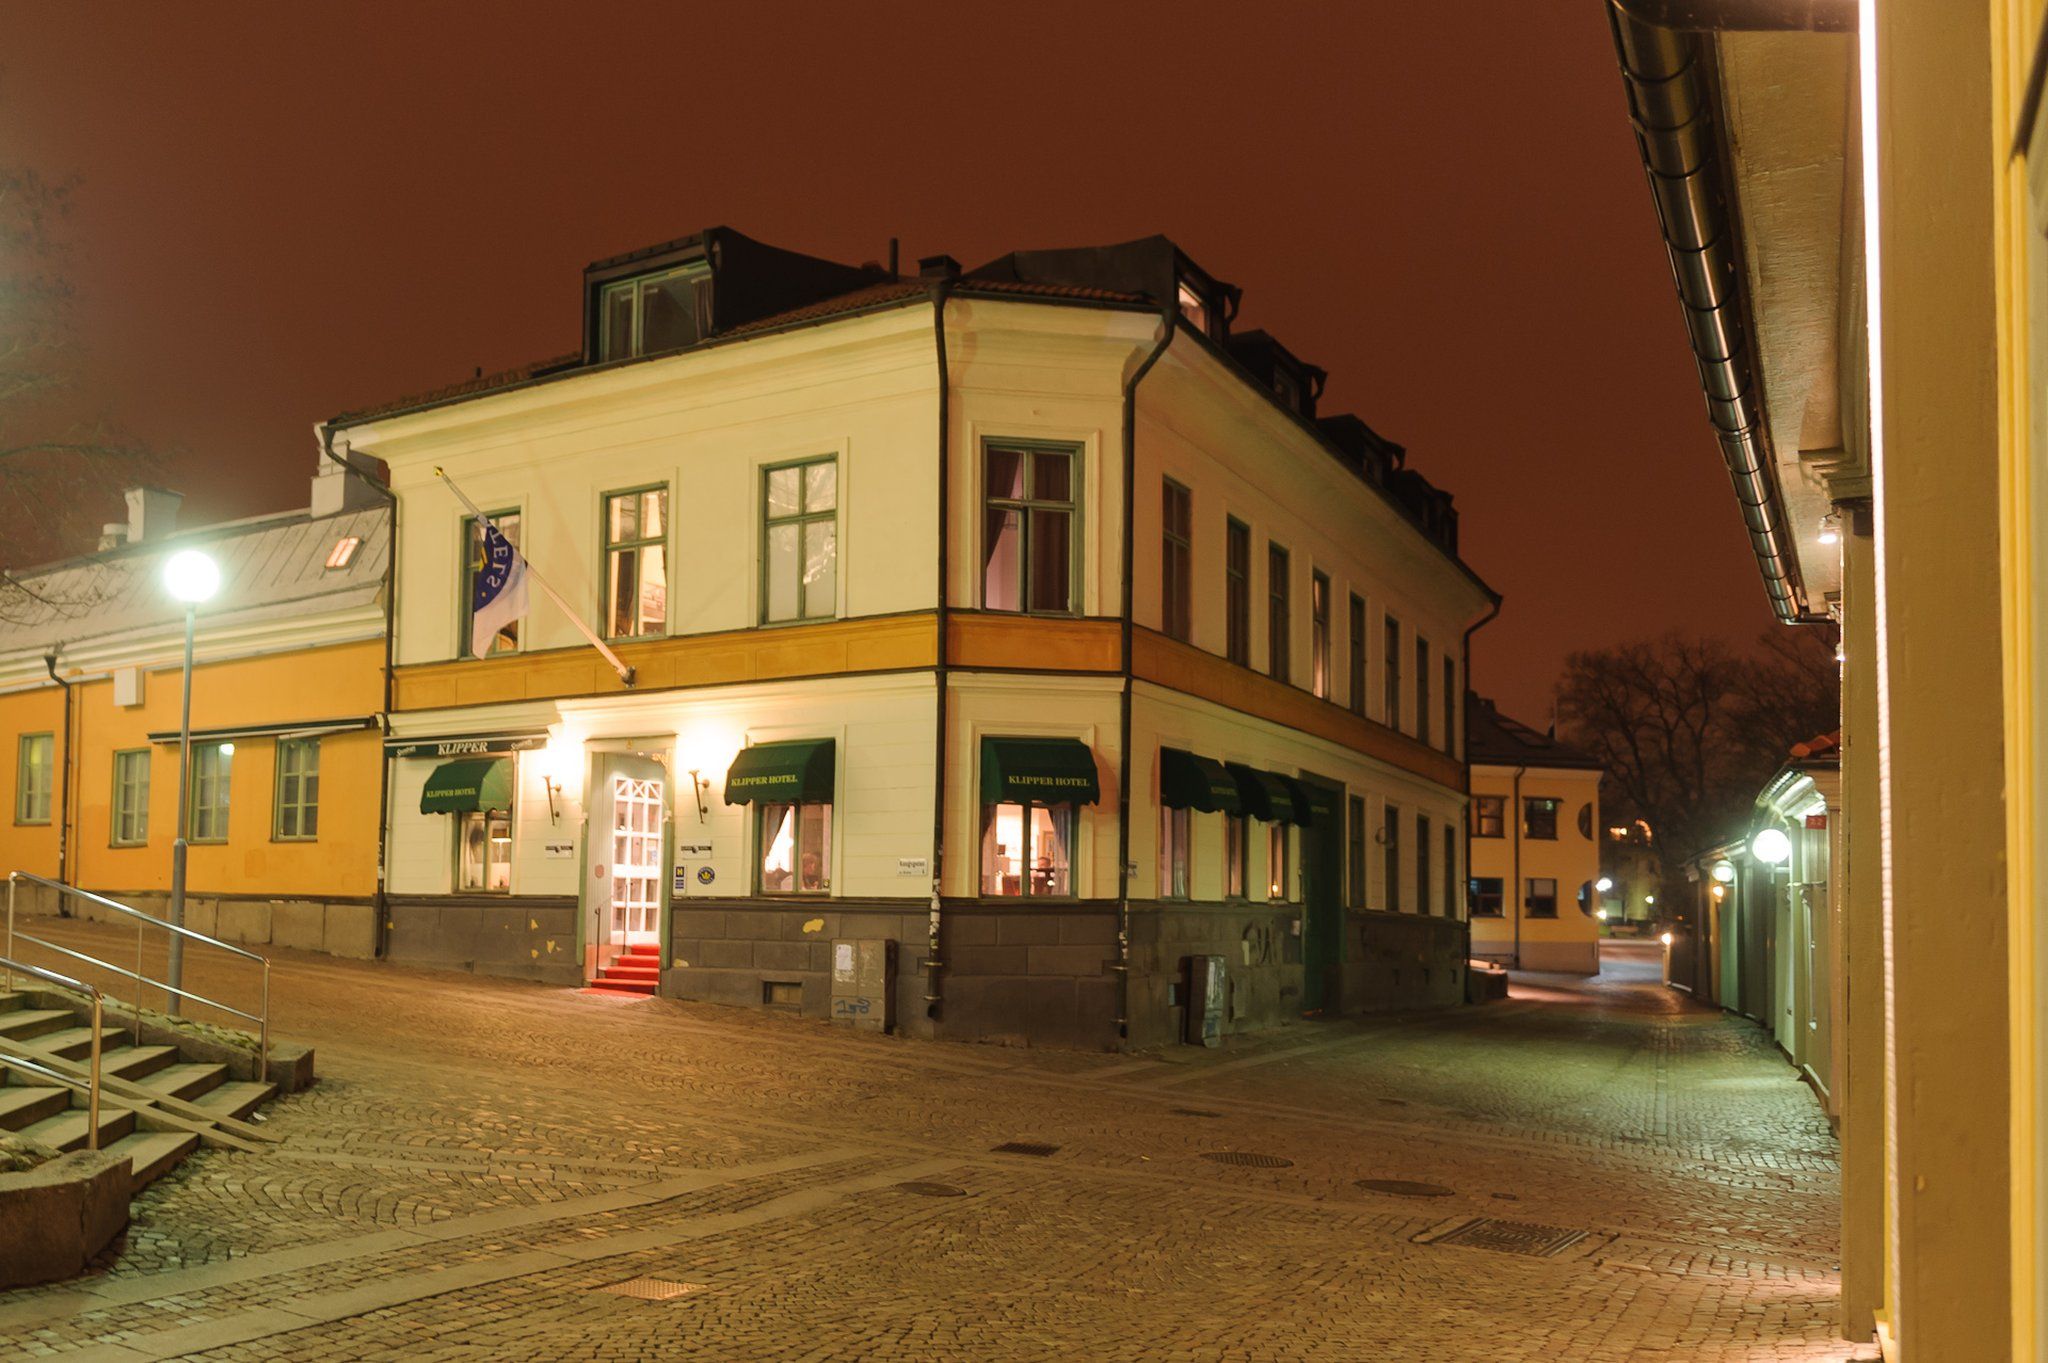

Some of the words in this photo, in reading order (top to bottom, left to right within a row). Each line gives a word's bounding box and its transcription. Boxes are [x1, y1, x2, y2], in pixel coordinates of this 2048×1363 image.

[437, 741, 488, 756] KLIPPER
[731, 776, 768, 786] KLIPPER
[769, 774, 798, 784] HOTEL
[1008, 775, 1053, 785] KLIPPER
[1055, 777, 1090, 787] HOTEL
